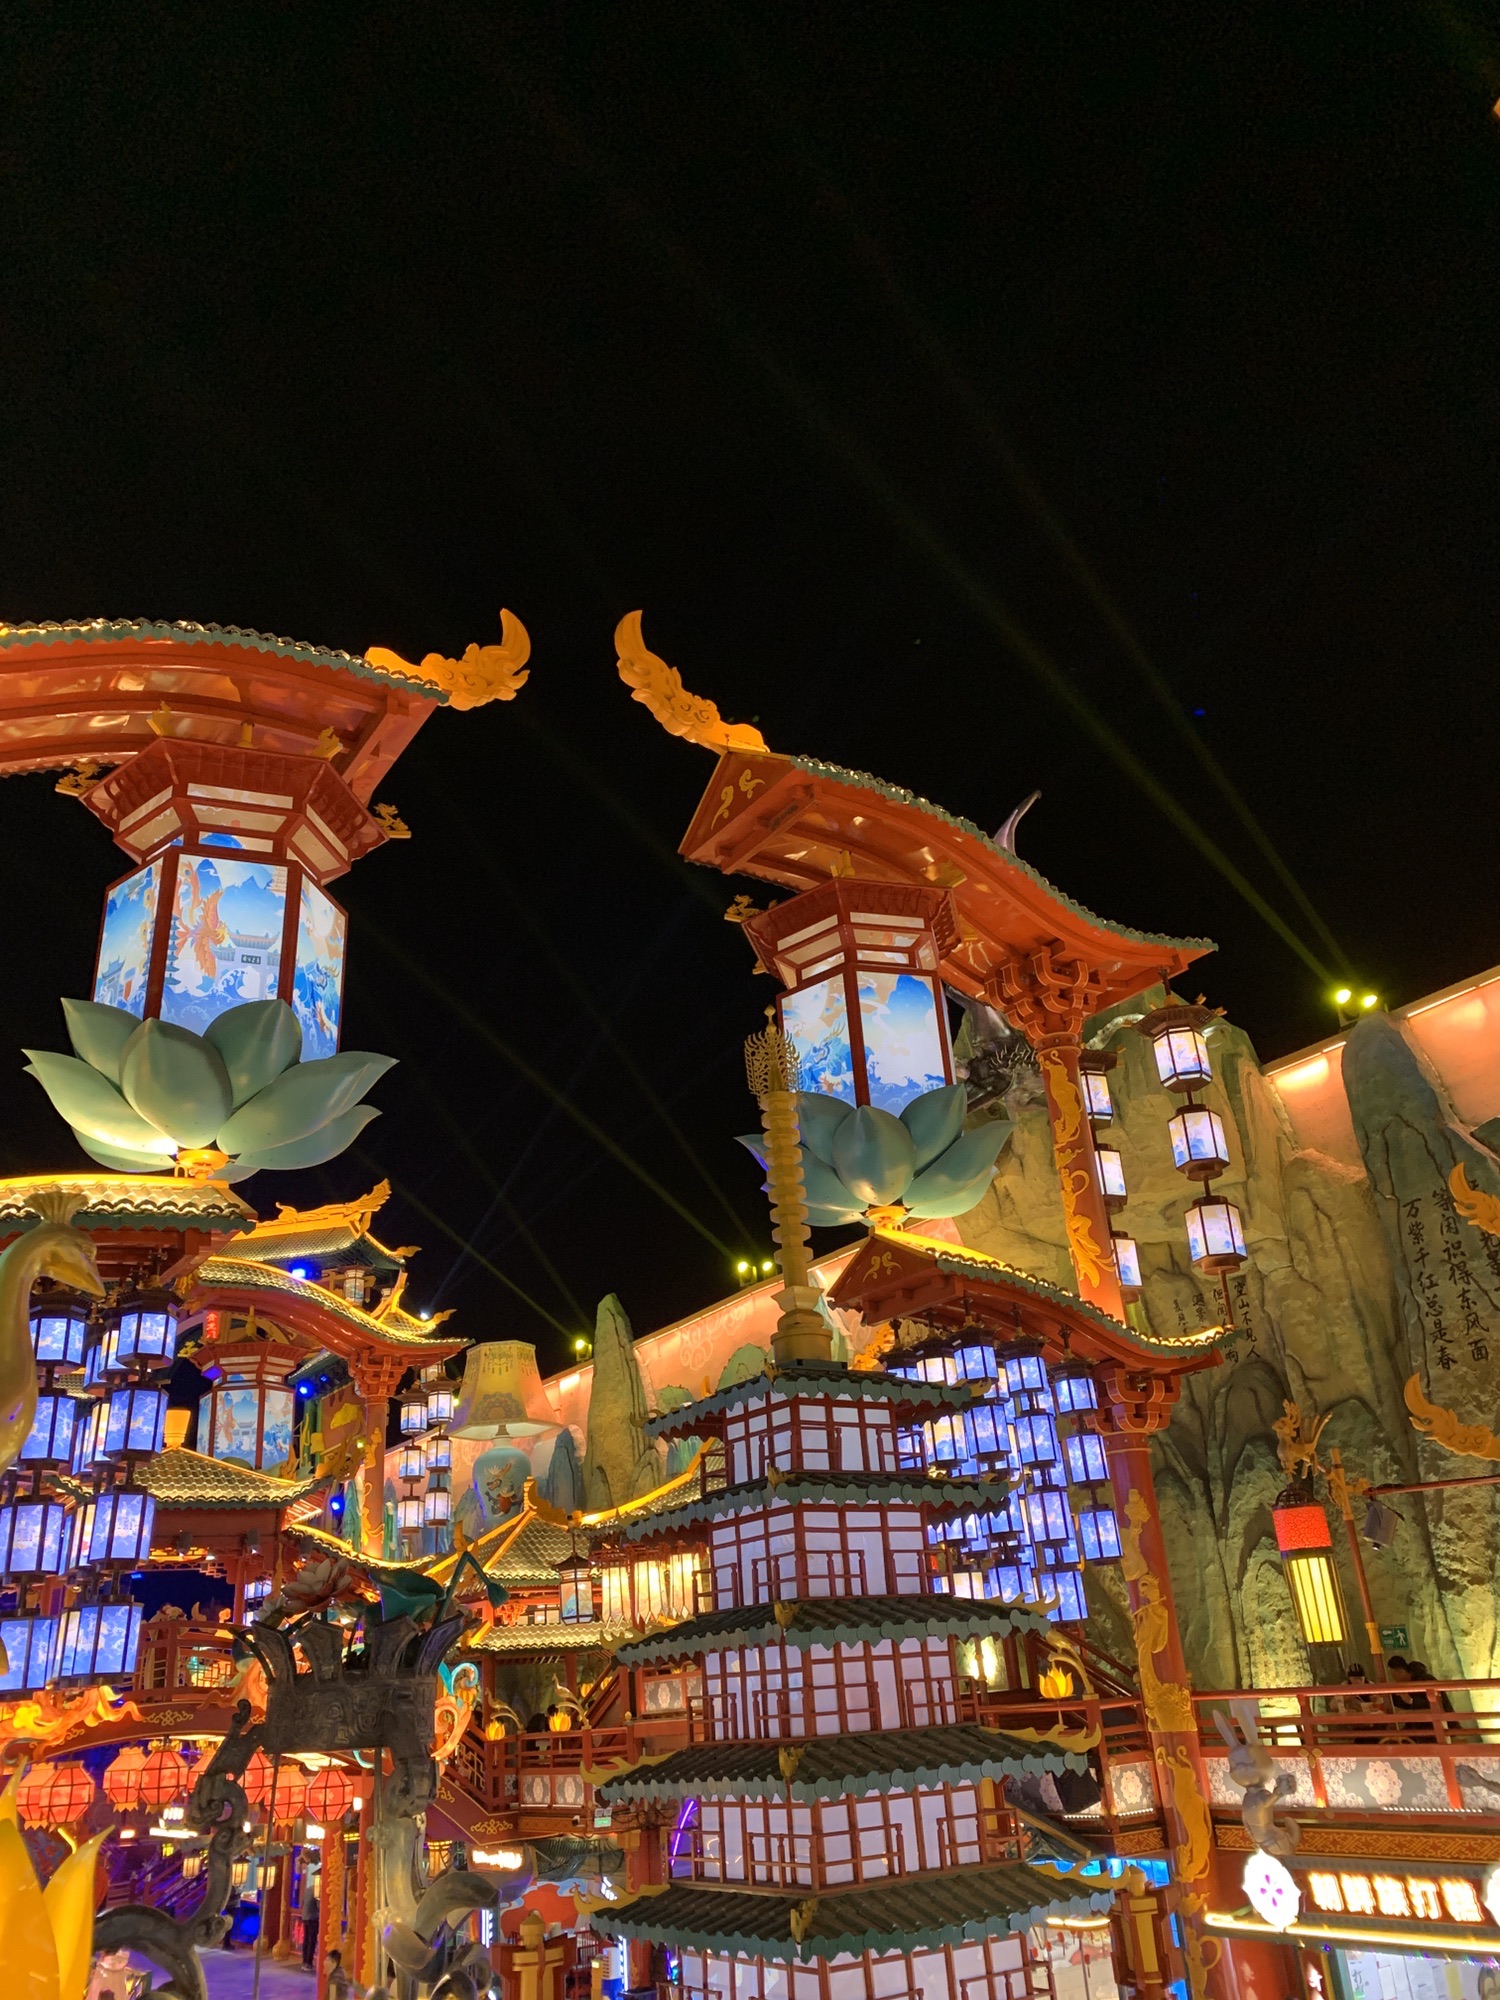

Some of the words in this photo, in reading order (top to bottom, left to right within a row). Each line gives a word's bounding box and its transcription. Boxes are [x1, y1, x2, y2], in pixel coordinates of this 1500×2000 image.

[1213, 1288, 1239, 1364] 但闻响
[1234, 1281, 1262, 1359] 空山不见人
[1402, 1197, 1458, 1371] 万紫千红总是春
[1432, 1187, 1490, 1362] 等闲识得东风面
